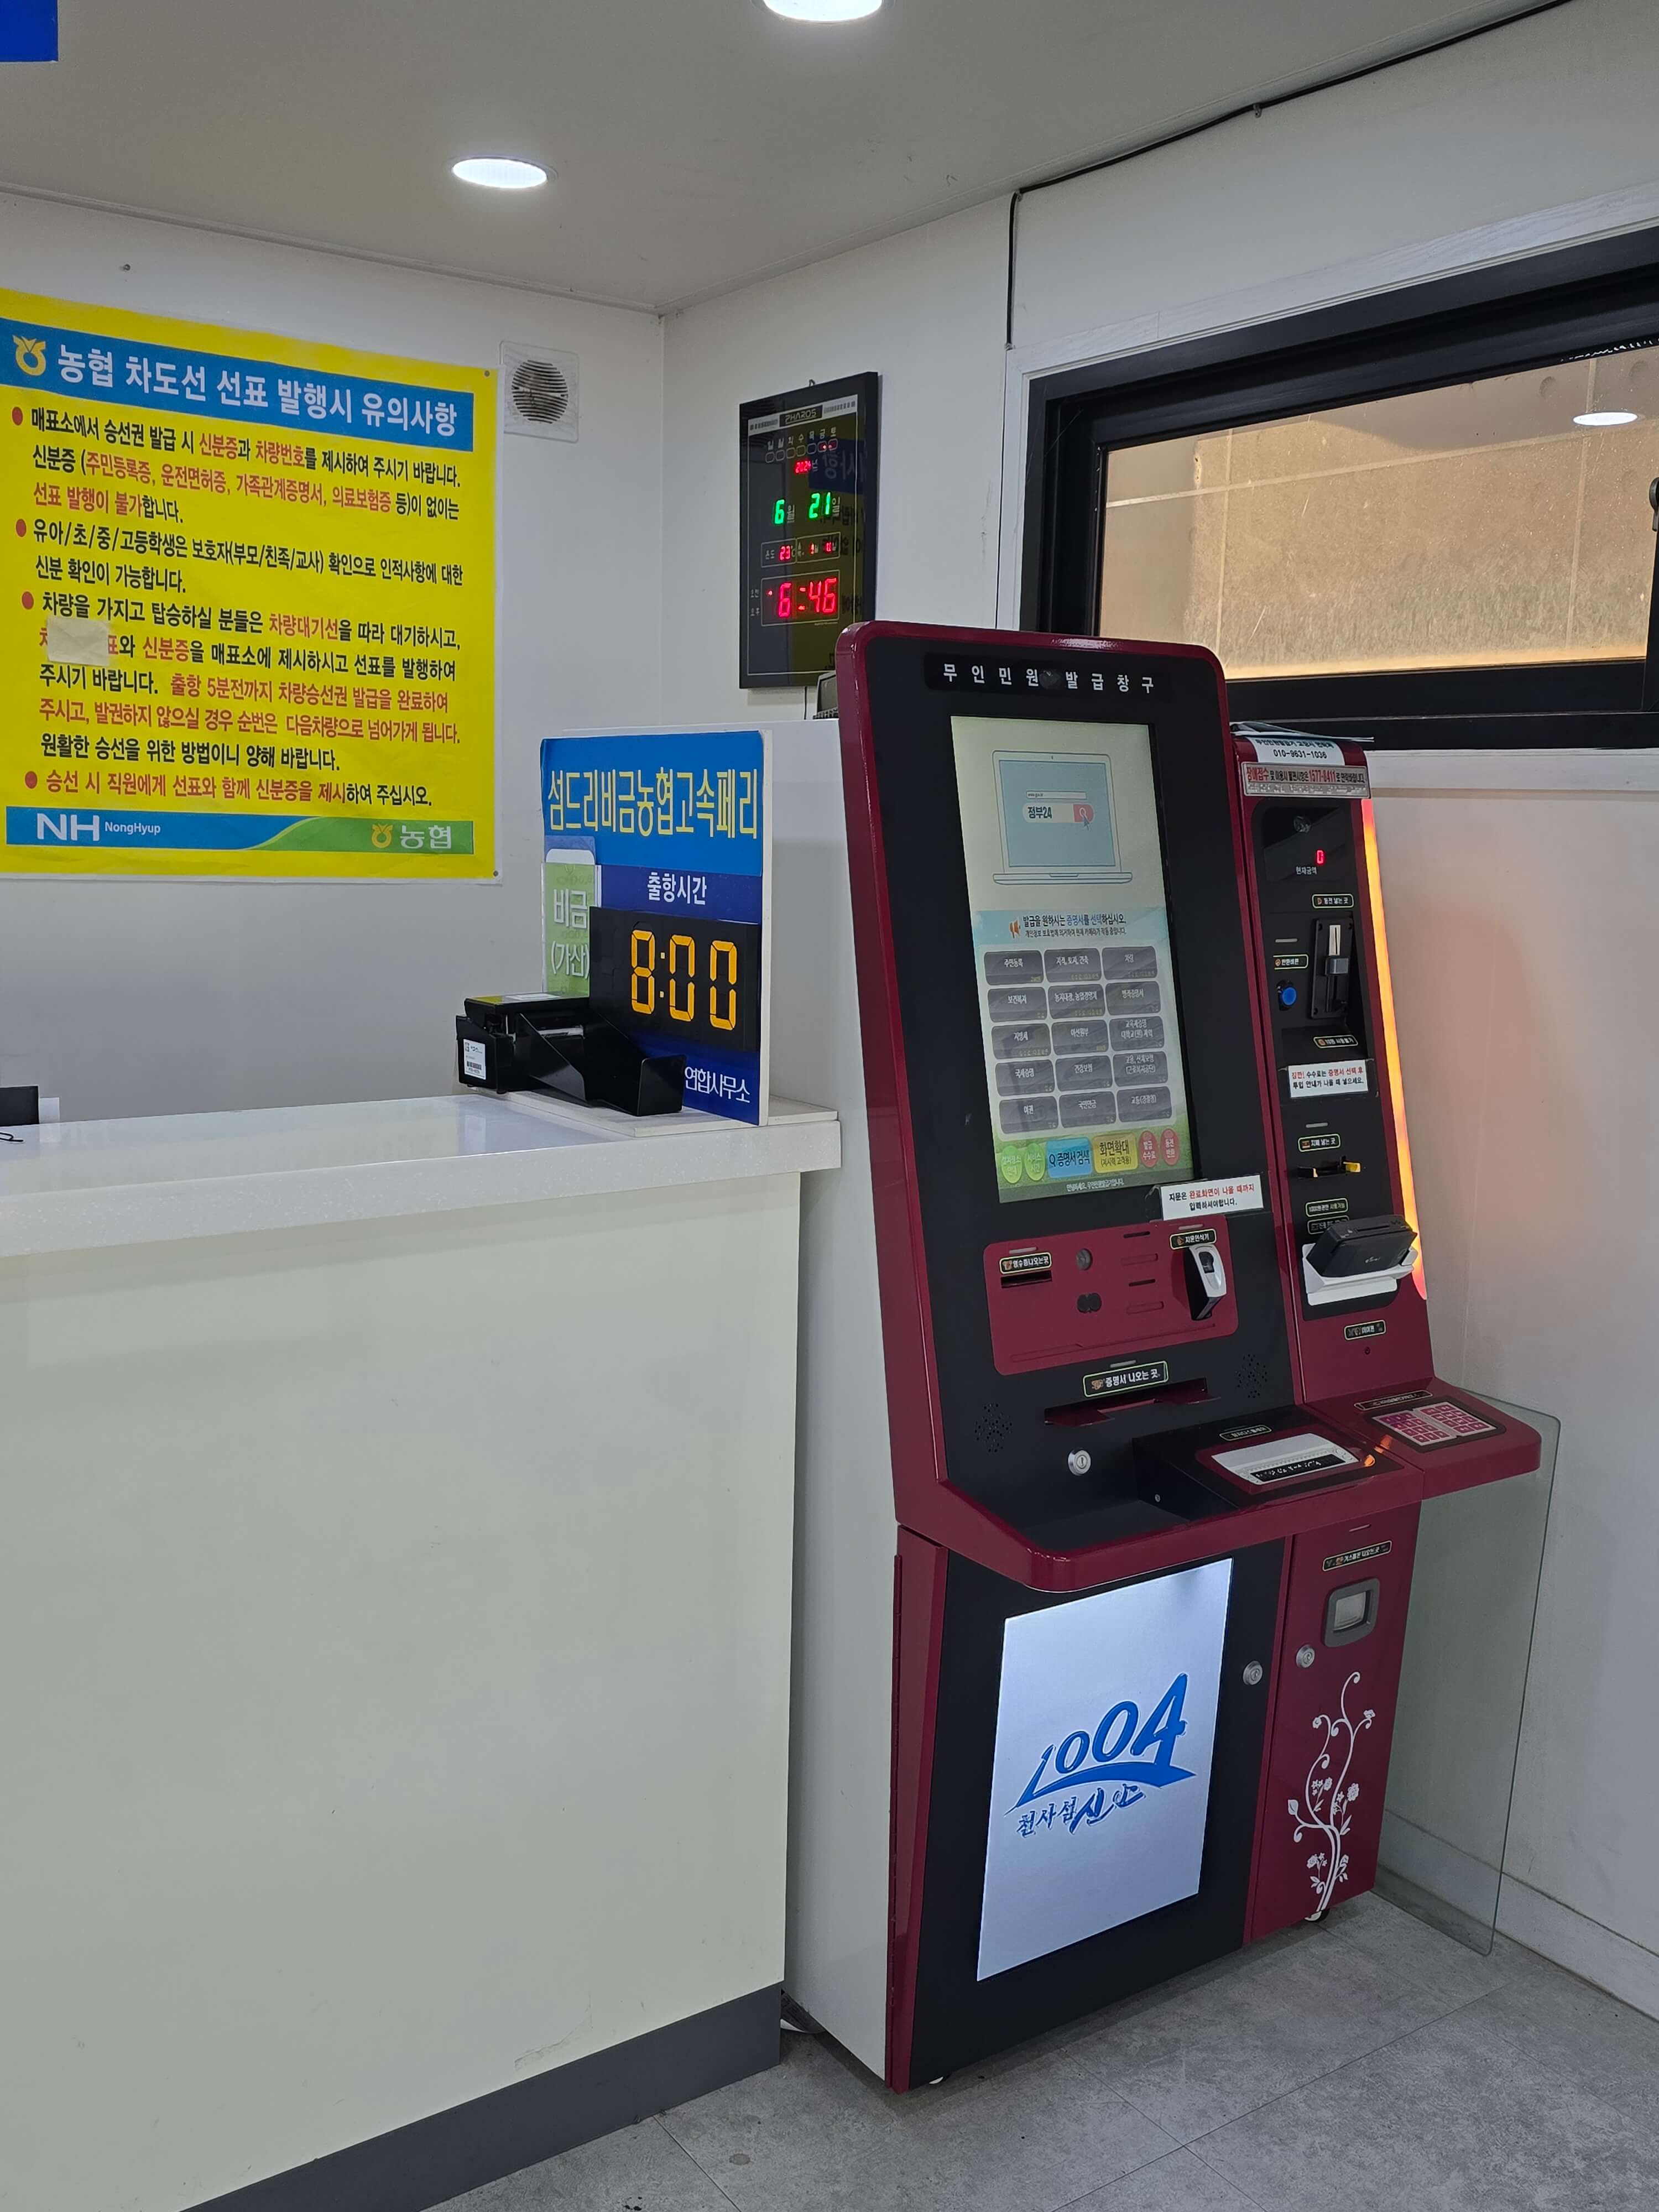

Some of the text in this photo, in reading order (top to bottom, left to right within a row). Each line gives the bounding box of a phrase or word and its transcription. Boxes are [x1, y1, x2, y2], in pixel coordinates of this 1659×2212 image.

[58, 345, 457, 436] 농협 차도선 선표 발행시 유의사항
[31, 406, 461, 488] 매표소에서 승선권 발급 시 신분증과 차량번호를 제시하여 주시기 바랍니다.
[32, 444, 460, 520] 신분증 (주민등록증, 운전면허증, 가족관계증명서, 의료보험증 등)이 없이는
[33, 482, 183, 524] 선표 발행이 불가합니다.
[774, 499, 785, 524] 6
[808, 492, 831, 519] 21
[33, 518, 463, 586] 유아/초/중/고등학생은 보호자(부모/친족/교사) 확인으로 인적사항에 대한
[35, 555, 186, 593] 신분 확인이 가능합니다.
[42, 591, 460, 651] 차량을 가지고 탑승하실 분들은 차량대기선을 따라 대기하시고,
[142, 637, 205, 664] 신분증을
[211, 643, 271, 669] 매표소에
[278, 648, 349, 674] 제시하시고
[354, 654, 396, 678] 선표를
[402, 658, 456, 682] 발행하여
[39, 664, 448, 713] 주시기 바랍니다. 출항 5분전까지 차량승선권 발급을 완료하여
[39, 698, 460, 744] 주시고, 발권하지 않으실 경우 순번은 다음차량으로 넘어가게 됩니다.
[40, 733, 340, 771] 원활한 승선을 위한 방법이니 양해 바랍니다.
[46, 769, 432, 806] 승선 시 직원에게 선표와 함께 신분증을 제시하여 주십시오.
[36, 813, 161, 842] NH NongHyup
[1027, 806, 1052, 819] 정부24
[399, 825, 452, 849] 농협
[647, 872, 707, 905] 출항시간
[554, 888, 588, 929] 비금
[1023, 913, 1126, 928] 발급을 원하시는 증명서를 선택하십시오.
[630, 929, 738, 1031] 8:00
[1293, 1081, 1304, 1089] 투입
[1306, 1080, 1322, 1088] 안내가
[1342, 1077, 1364, 1085] 넣으세요.
[1307, 1070, 1327, 1078] 수수료는
[1328, 1068, 1344, 1077] 증명서
[1346, 1067, 1357, 1075] 선택
[1057, 1151, 1076, 1167] 증명서
[1077, 1150, 1091, 1165] 검색
[1099, 1139, 1130, 1157] 화면확대
[1168, 1183, 1255, 1202] 지문은 완료화면이 나올 때까지
[1185, 1233, 1209, 1244] 지문인식기
[1105, 1369, 1159, 1388] 증명서 나오는 곳
[1016, 1796, 1077, 1838] 천사섬
